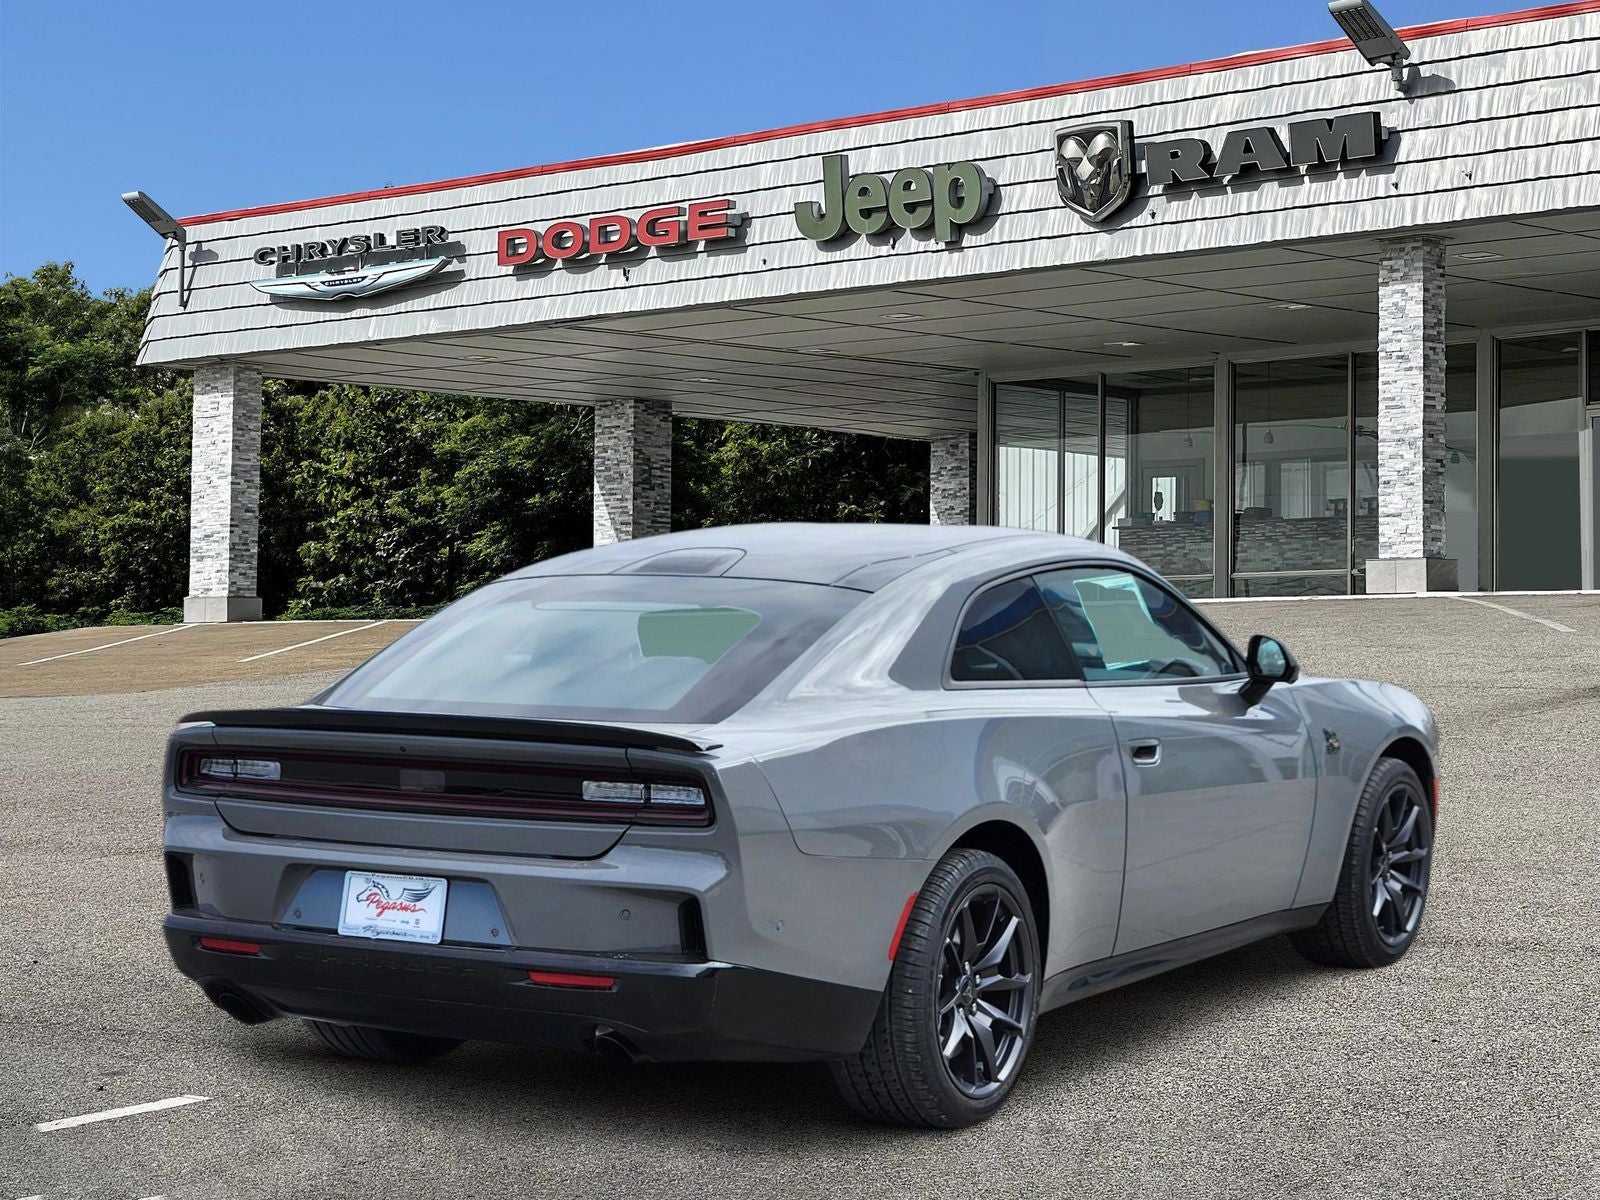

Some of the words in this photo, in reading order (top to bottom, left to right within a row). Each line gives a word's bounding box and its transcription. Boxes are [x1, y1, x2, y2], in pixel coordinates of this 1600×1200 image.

[1146, 111, 1380, 187] RAM
[794, 154, 989, 242] Jeep
[253, 225, 448, 266] CHRYSLER
[498, 199, 736, 267] DODGE
[324, 277, 363, 286] CHRYSLER
[366, 892, 427, 917] Pegasus
